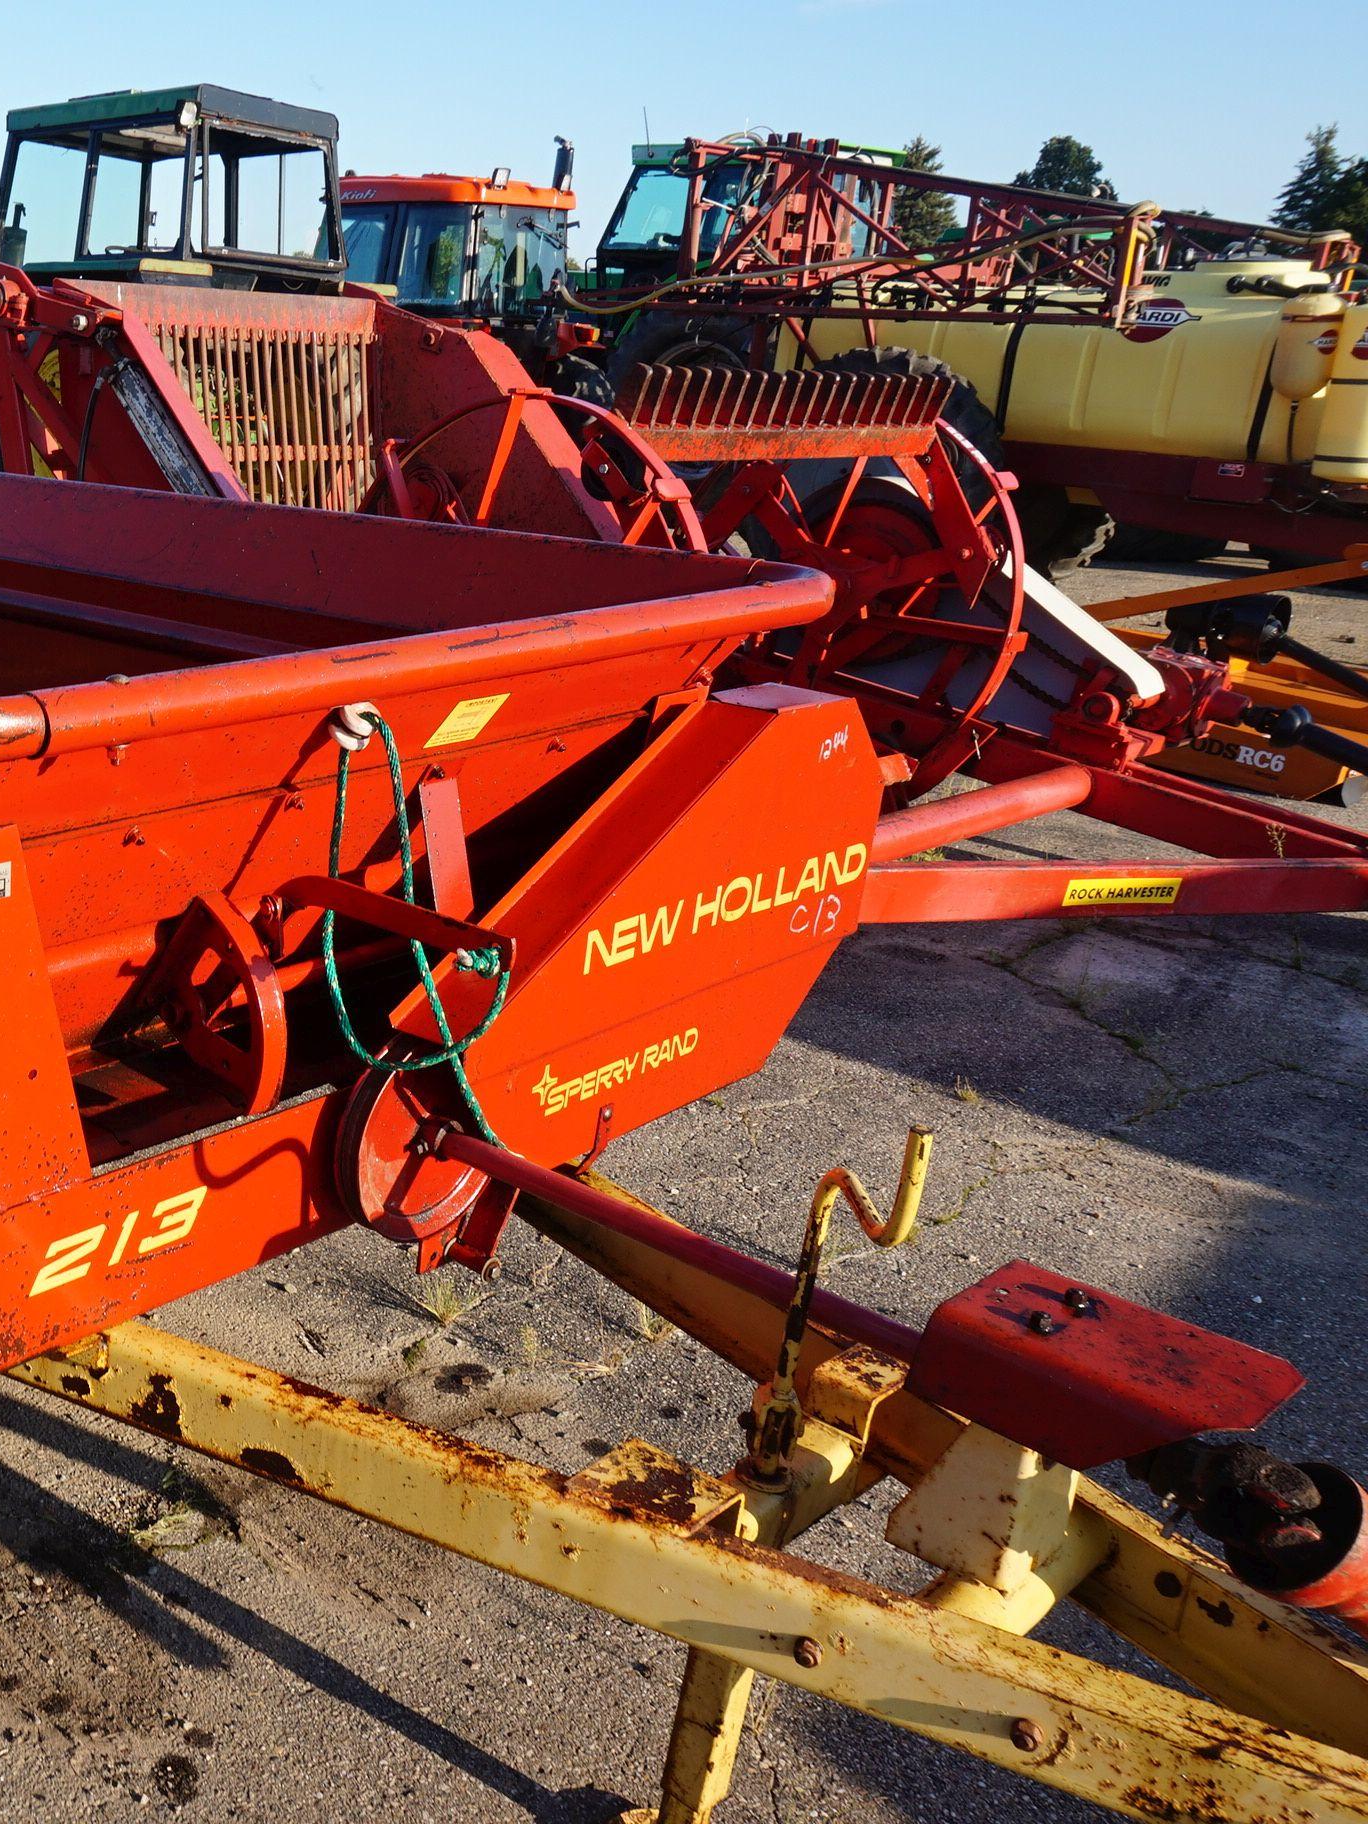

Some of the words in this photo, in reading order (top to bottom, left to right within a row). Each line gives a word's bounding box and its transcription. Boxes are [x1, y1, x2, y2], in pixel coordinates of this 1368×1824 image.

[1135, 311, 1181, 323] ARDI
[583, 899, 685, 976] NEW
[691, 842, 868, 935] HOLLAND
[1069, 888, 1105, 900] ROCK
[1106, 886, 1175, 899] HARVESTER
[544, 1052, 640, 1117] SPERRY
[641, 1027, 699, 1074] RAND
[29, 1185, 208, 1298] 213
